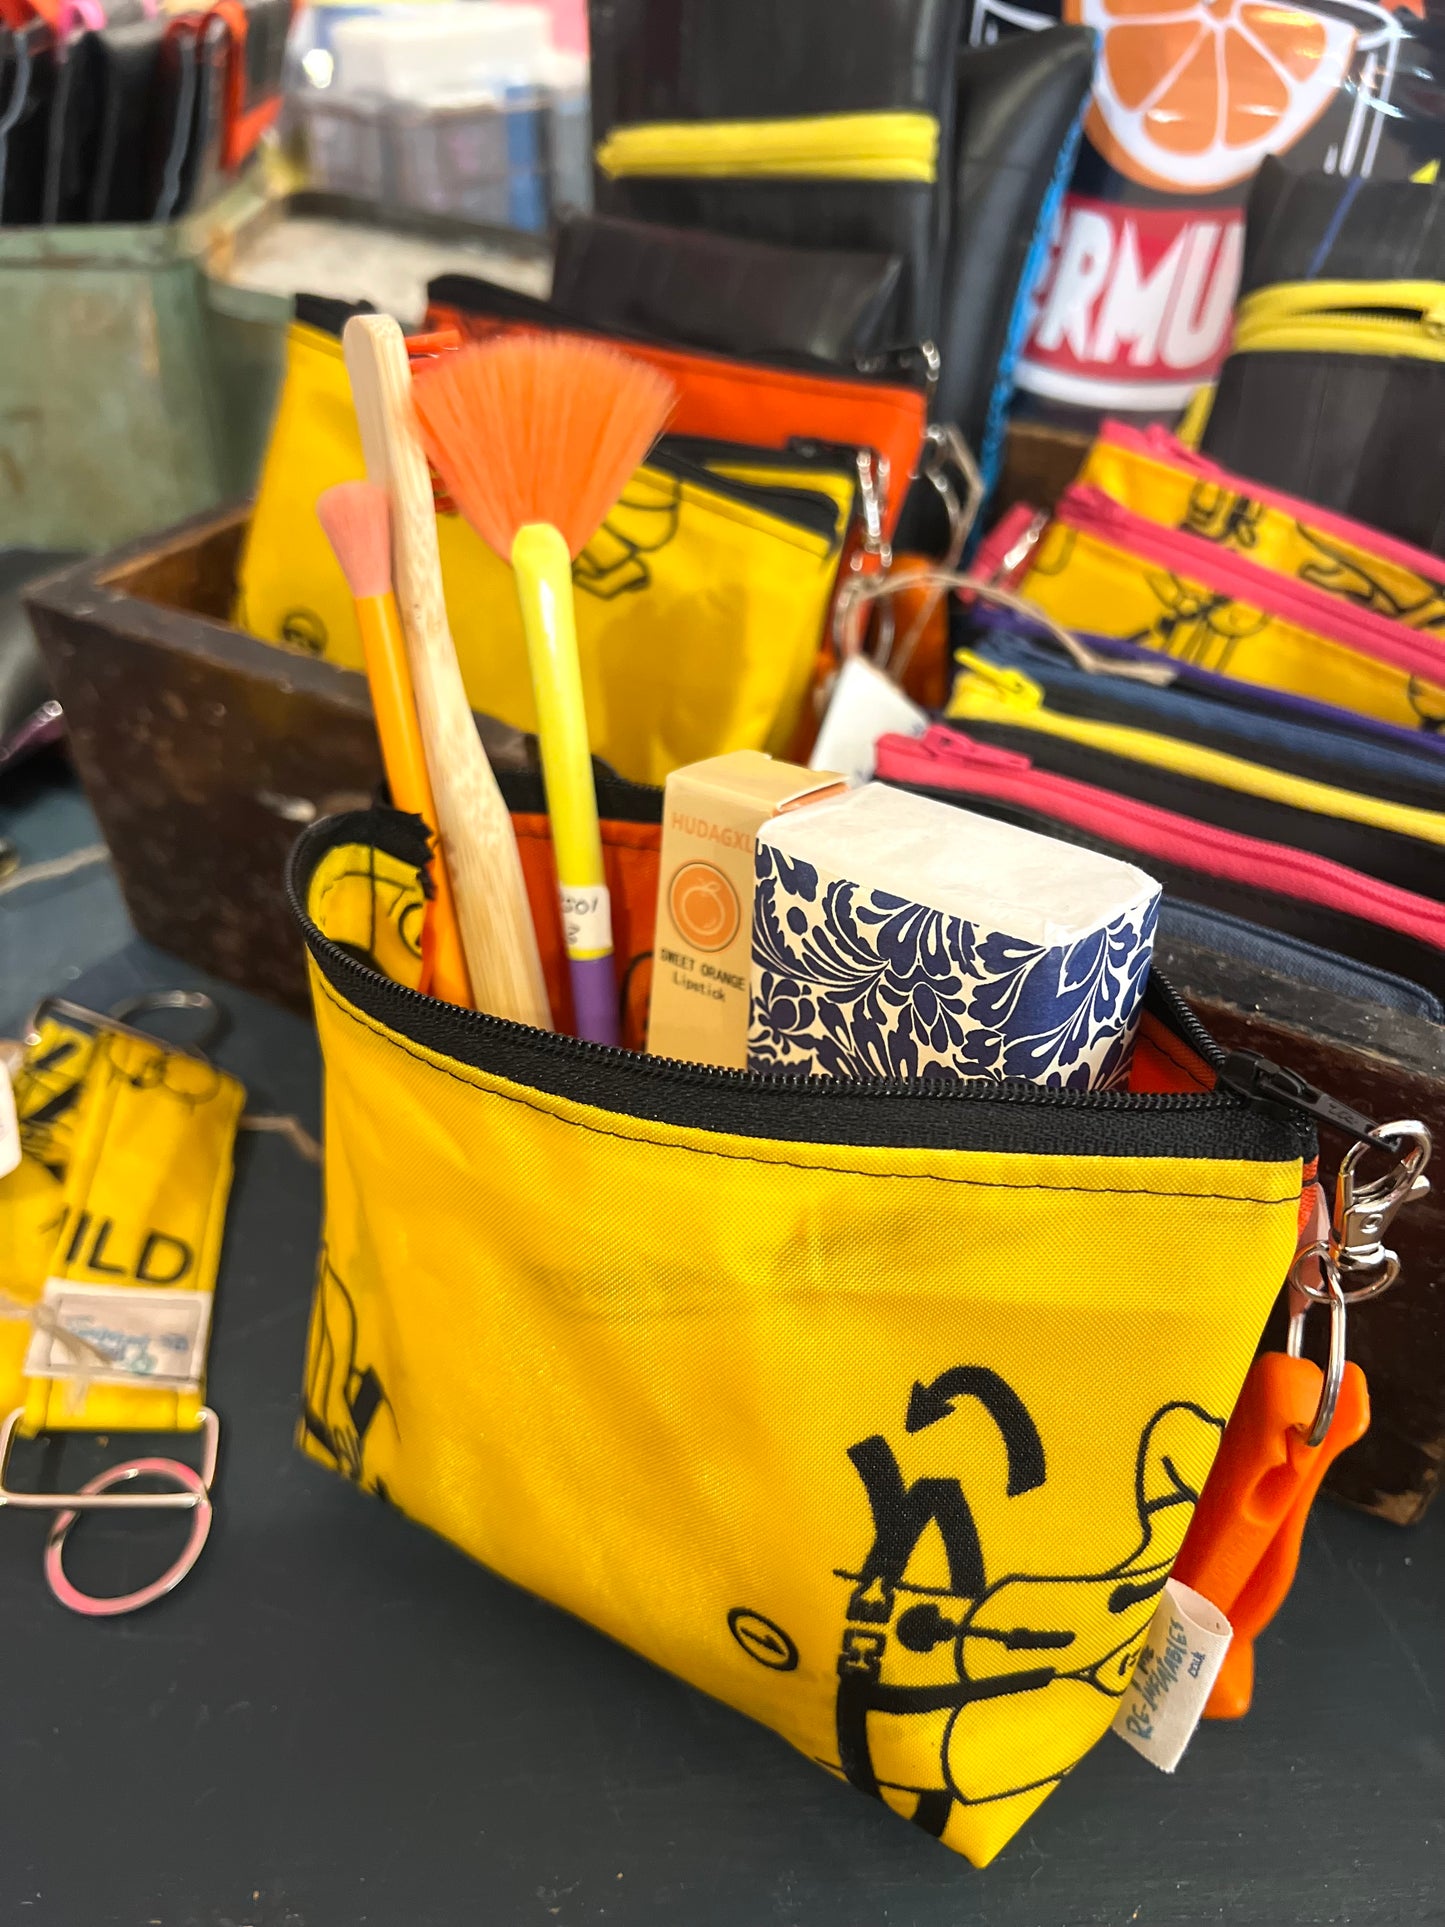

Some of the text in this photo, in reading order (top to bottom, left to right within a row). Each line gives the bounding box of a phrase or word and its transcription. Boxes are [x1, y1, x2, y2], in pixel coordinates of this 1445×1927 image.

[1026, 206, 1245, 369] RMU
[660, 947, 746, 991] SWEET ORANGE
[672, 971, 726, 1002] Lipstick
